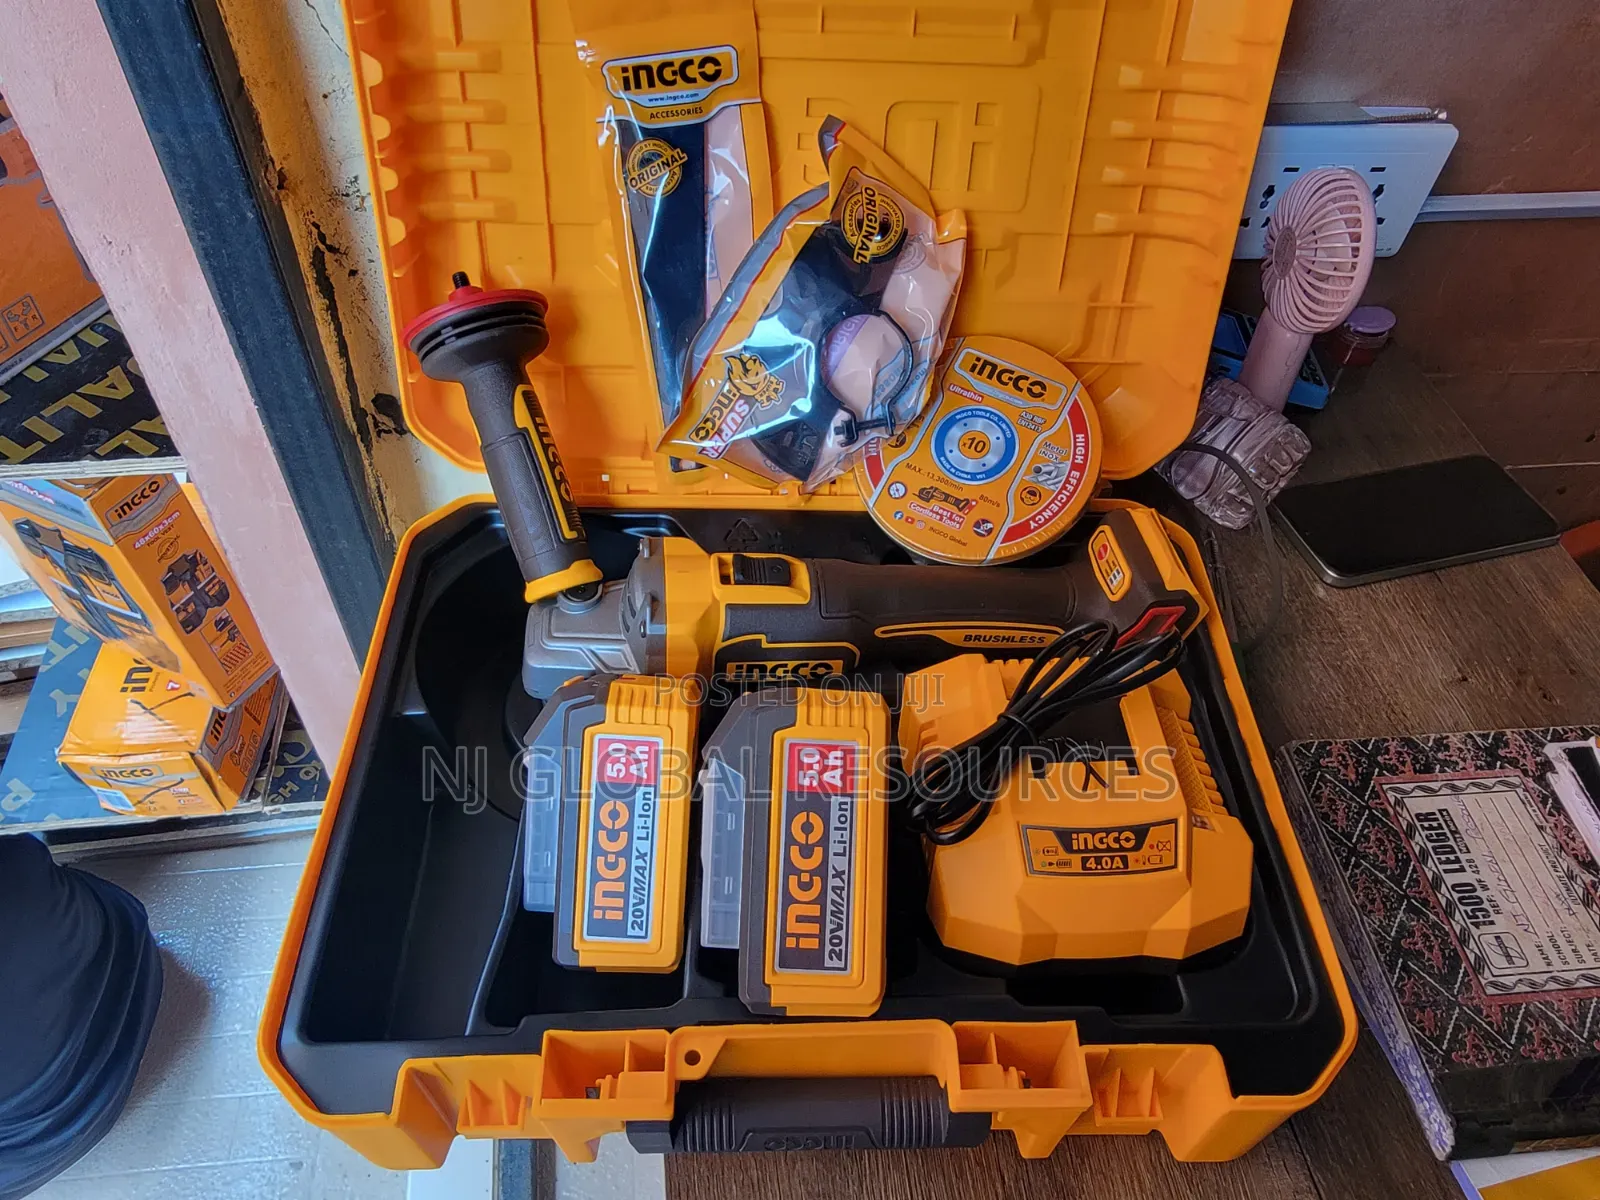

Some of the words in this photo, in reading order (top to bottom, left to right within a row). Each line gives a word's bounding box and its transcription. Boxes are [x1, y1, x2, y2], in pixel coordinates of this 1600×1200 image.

[648, 92, 700, 103] www.ingco.com
[649, 106, 704, 120] ACCESSORIES
[629, 149, 687, 189] ORIGINAL
[855, 186, 877, 263] ORIGINAL
[949, 384, 983, 402] Ultrathin
[1043, 440, 1068, 457] Metal
[1074, 433, 1086, 464] HIGH
[910, 502, 940, 520] Cordless
[941, 516, 960, 529] Tools
[933, 504, 951, 518] Best
[951, 513, 964, 522] for
[1029, 470, 1081, 530] EFFICIENCY
[962, 633, 1047, 645] BRUSHLESS
[605, 741, 628, 780] 5.0
[628, 744, 650, 780] Ah
[798, 746, 822, 788] 5.0
[822, 749, 844, 788] Ah
[636, 790, 653, 843] Li-Ion
[832, 800, 849, 859] Li-Ion
[1411, 810, 1468, 874] LEDGER
[1085, 857, 1125, 871] 4.0A
[1464, 857, 1481, 875] 428
[1474, 876, 1491, 892] WF
[1449, 881, 1498, 931] 1500
